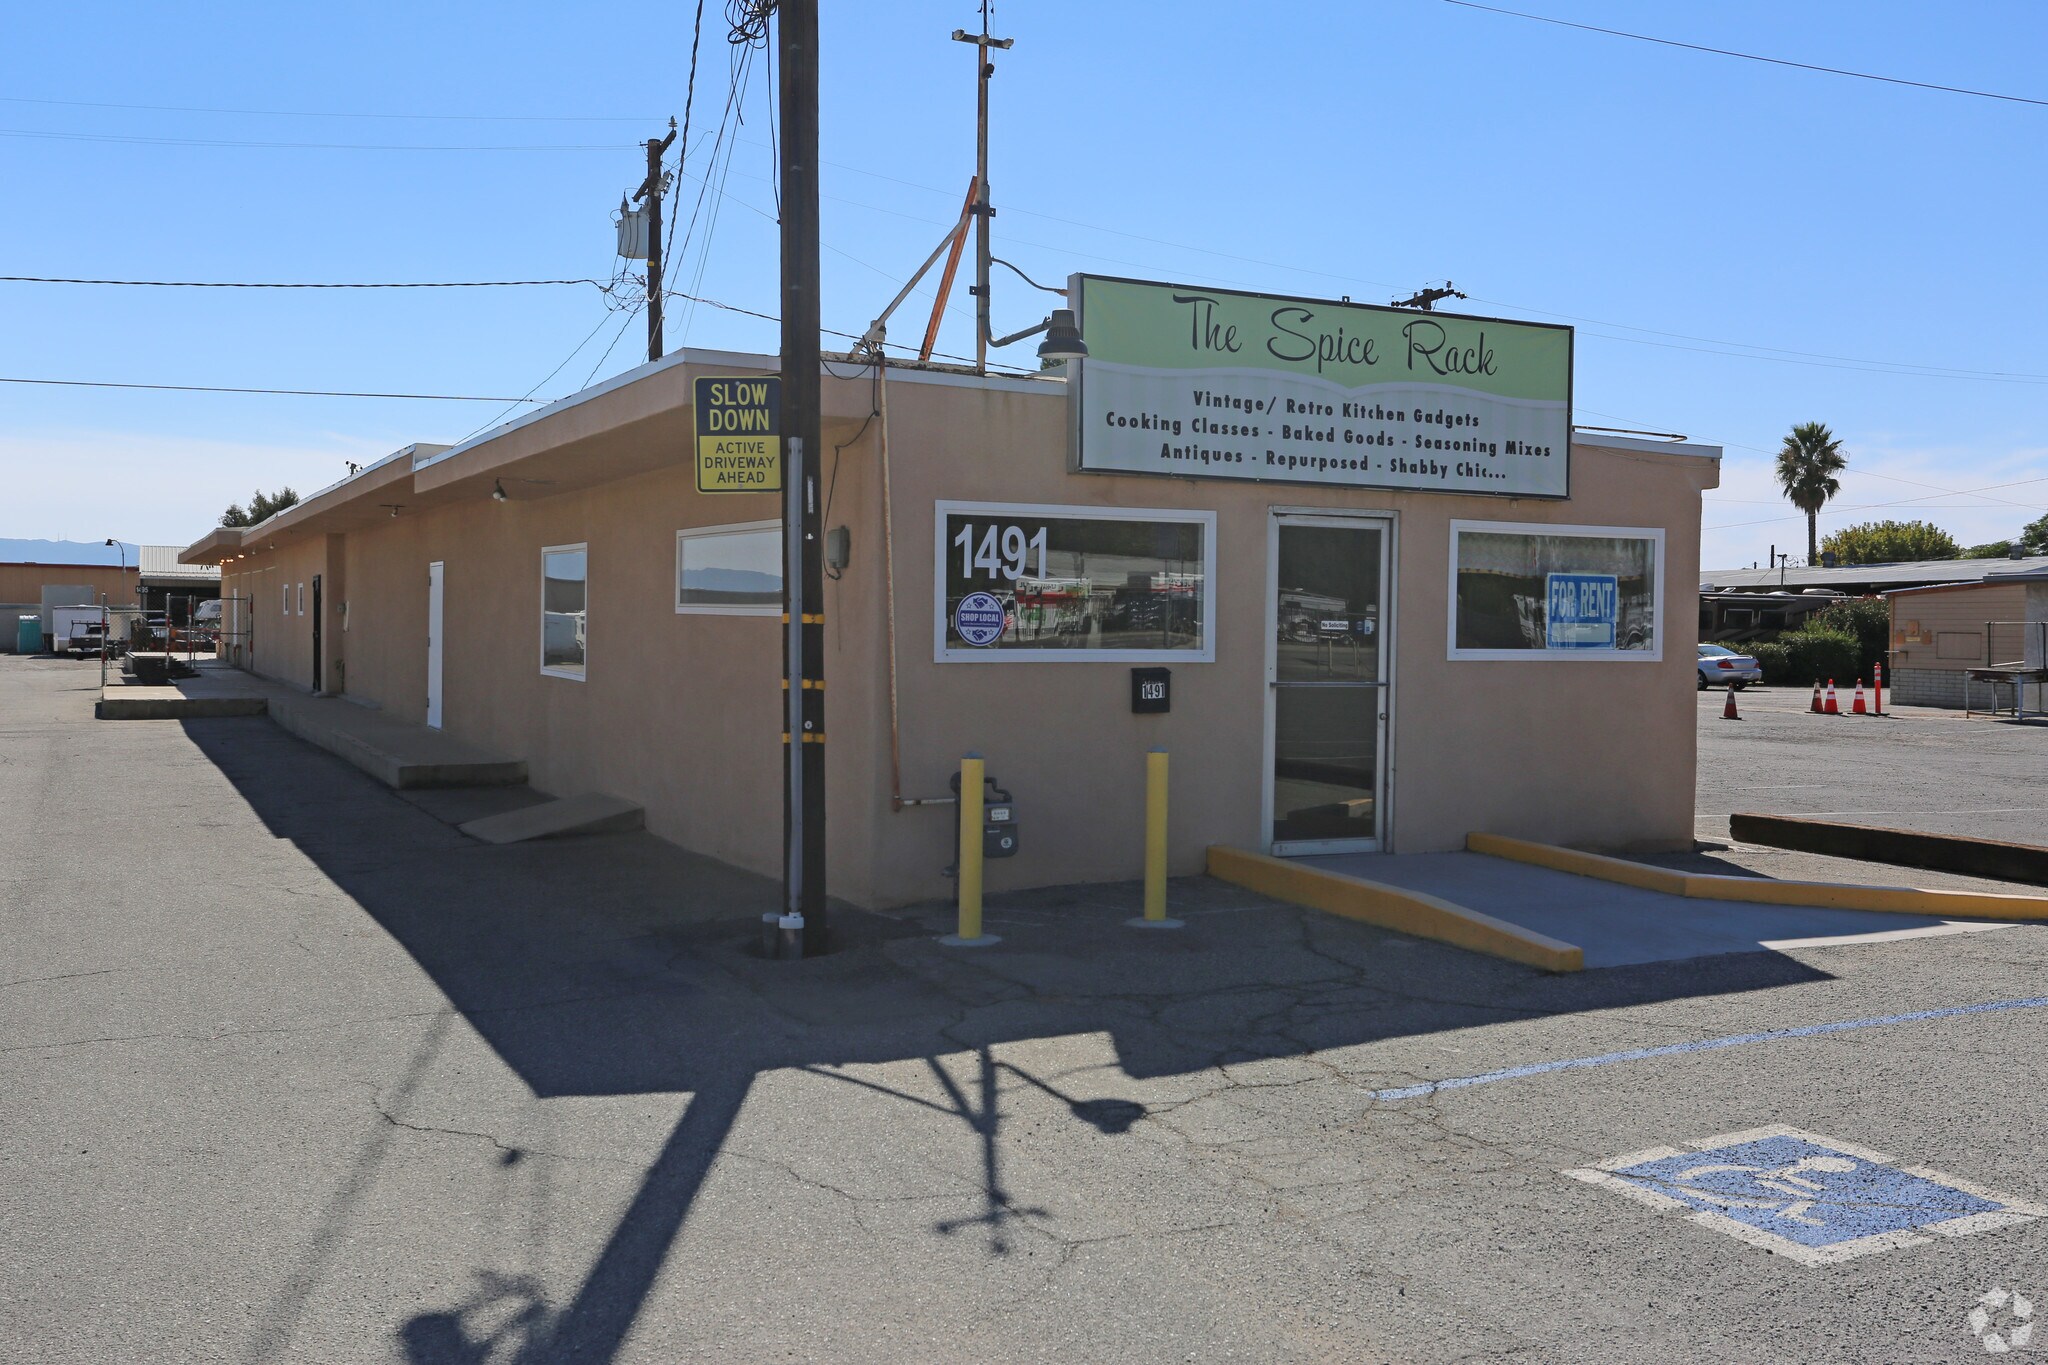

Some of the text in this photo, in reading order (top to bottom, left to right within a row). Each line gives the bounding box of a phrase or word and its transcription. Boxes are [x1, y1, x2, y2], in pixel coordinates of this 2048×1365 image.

[1173, 293, 1498, 376] The Spice Rack
[710, 383, 768, 406] SLOW
[709, 408, 769, 431] DOWN
[1193, 390, 1479, 429] Vintage/ Retro Kitchen Gadgets
[1106, 411, 1182, 436] Cooking
[1191, 417, 1259, 437] Classes
[1282, 424, 1335, 443] Baked
[1344, 429, 1394, 447] Goods
[1415, 434, 1497, 457] Seasoning
[1505, 440, 1551, 457] Mixes
[715, 442, 765, 454] ACTIVE
[704, 456, 776, 469] DRIVEWAY
[1160, 443, 1243, 465] Antiques
[1266, 450, 1369, 472] Repurposed
[1390, 457, 1448, 479] Shabby
[1456, 462, 1507, 479] Chic...
[716, 471, 765, 484] AHEAD
[954, 523, 1047, 581] 1491
[1551, 580, 1613, 618] FOR RENT
[960, 612, 1000, 623] SHOP LOCAL
[1142, 683, 1165, 699] 1491
